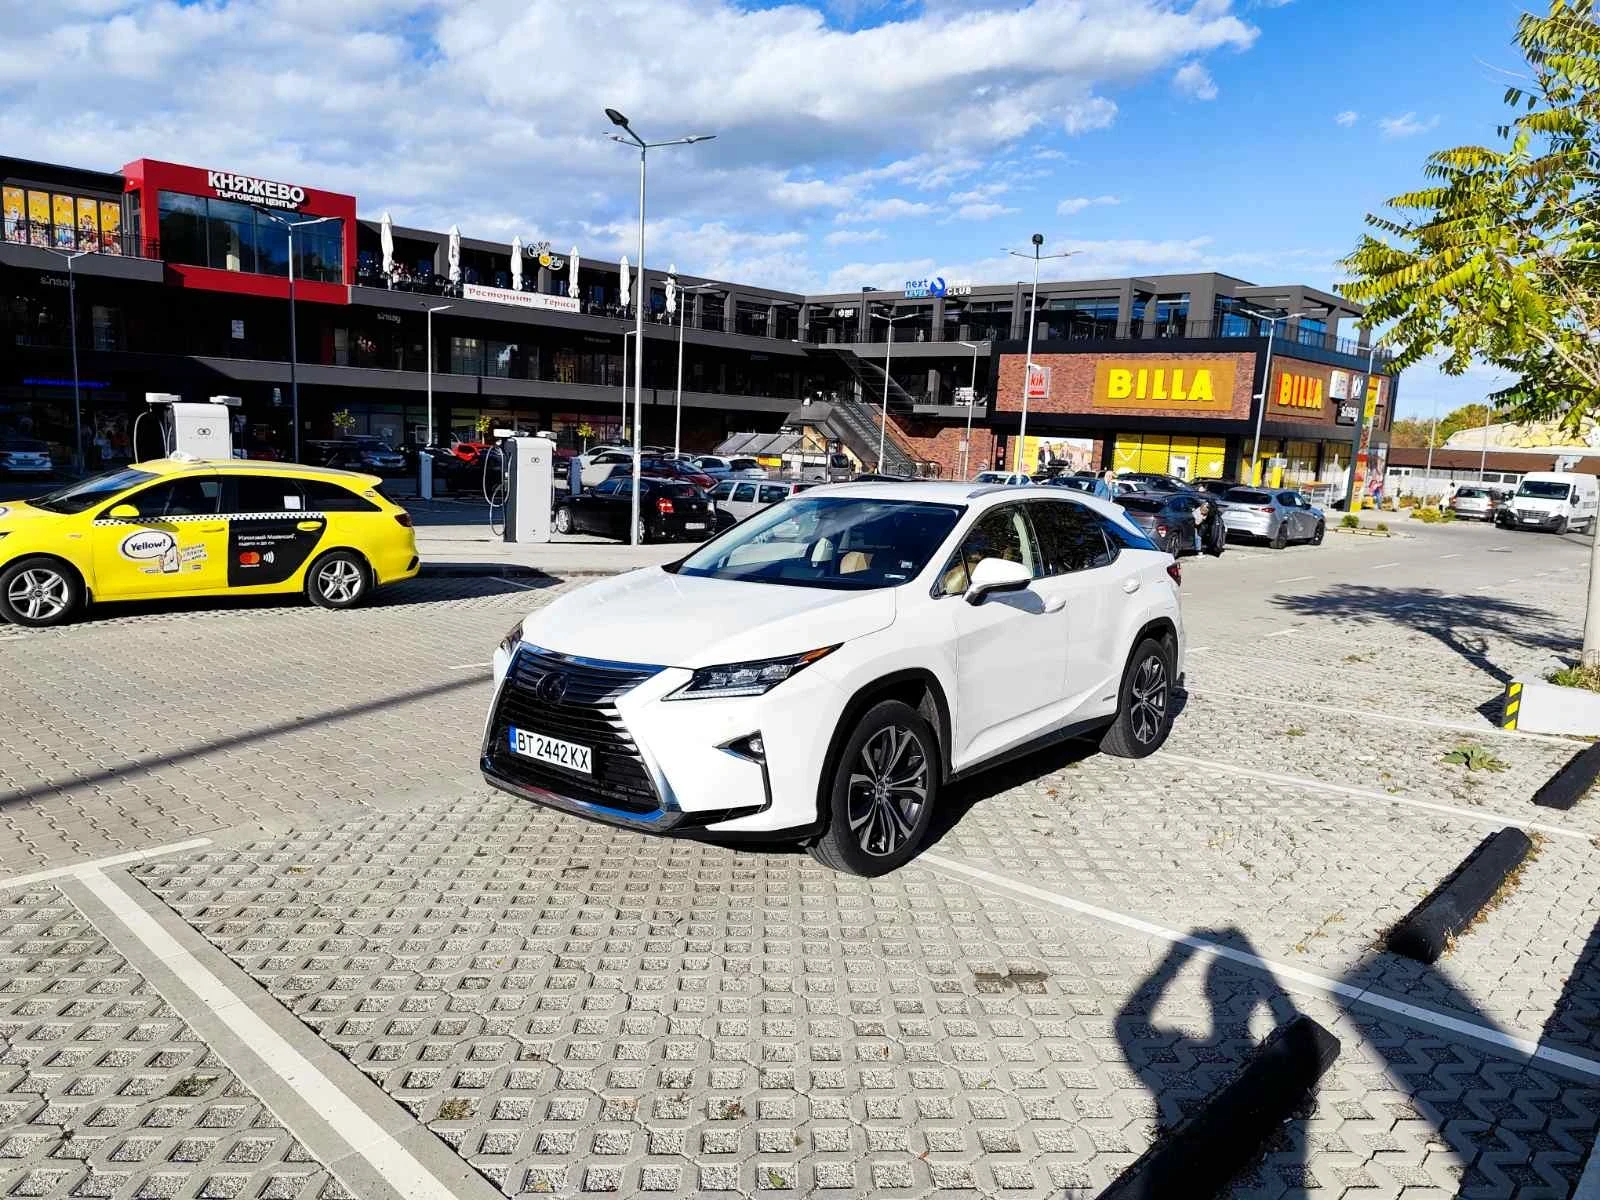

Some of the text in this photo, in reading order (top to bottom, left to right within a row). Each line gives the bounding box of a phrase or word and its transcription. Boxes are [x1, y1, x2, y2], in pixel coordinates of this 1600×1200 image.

[208, 171, 305, 203] КНЯЖЕВО
[905, 279, 928, 289] next
[947, 287, 971, 296] CLUB
[1108, 368, 1214, 401] BILLA
[1276, 372, 1322, 409] BILLA
[131, 538, 166, 551] Yellow!
